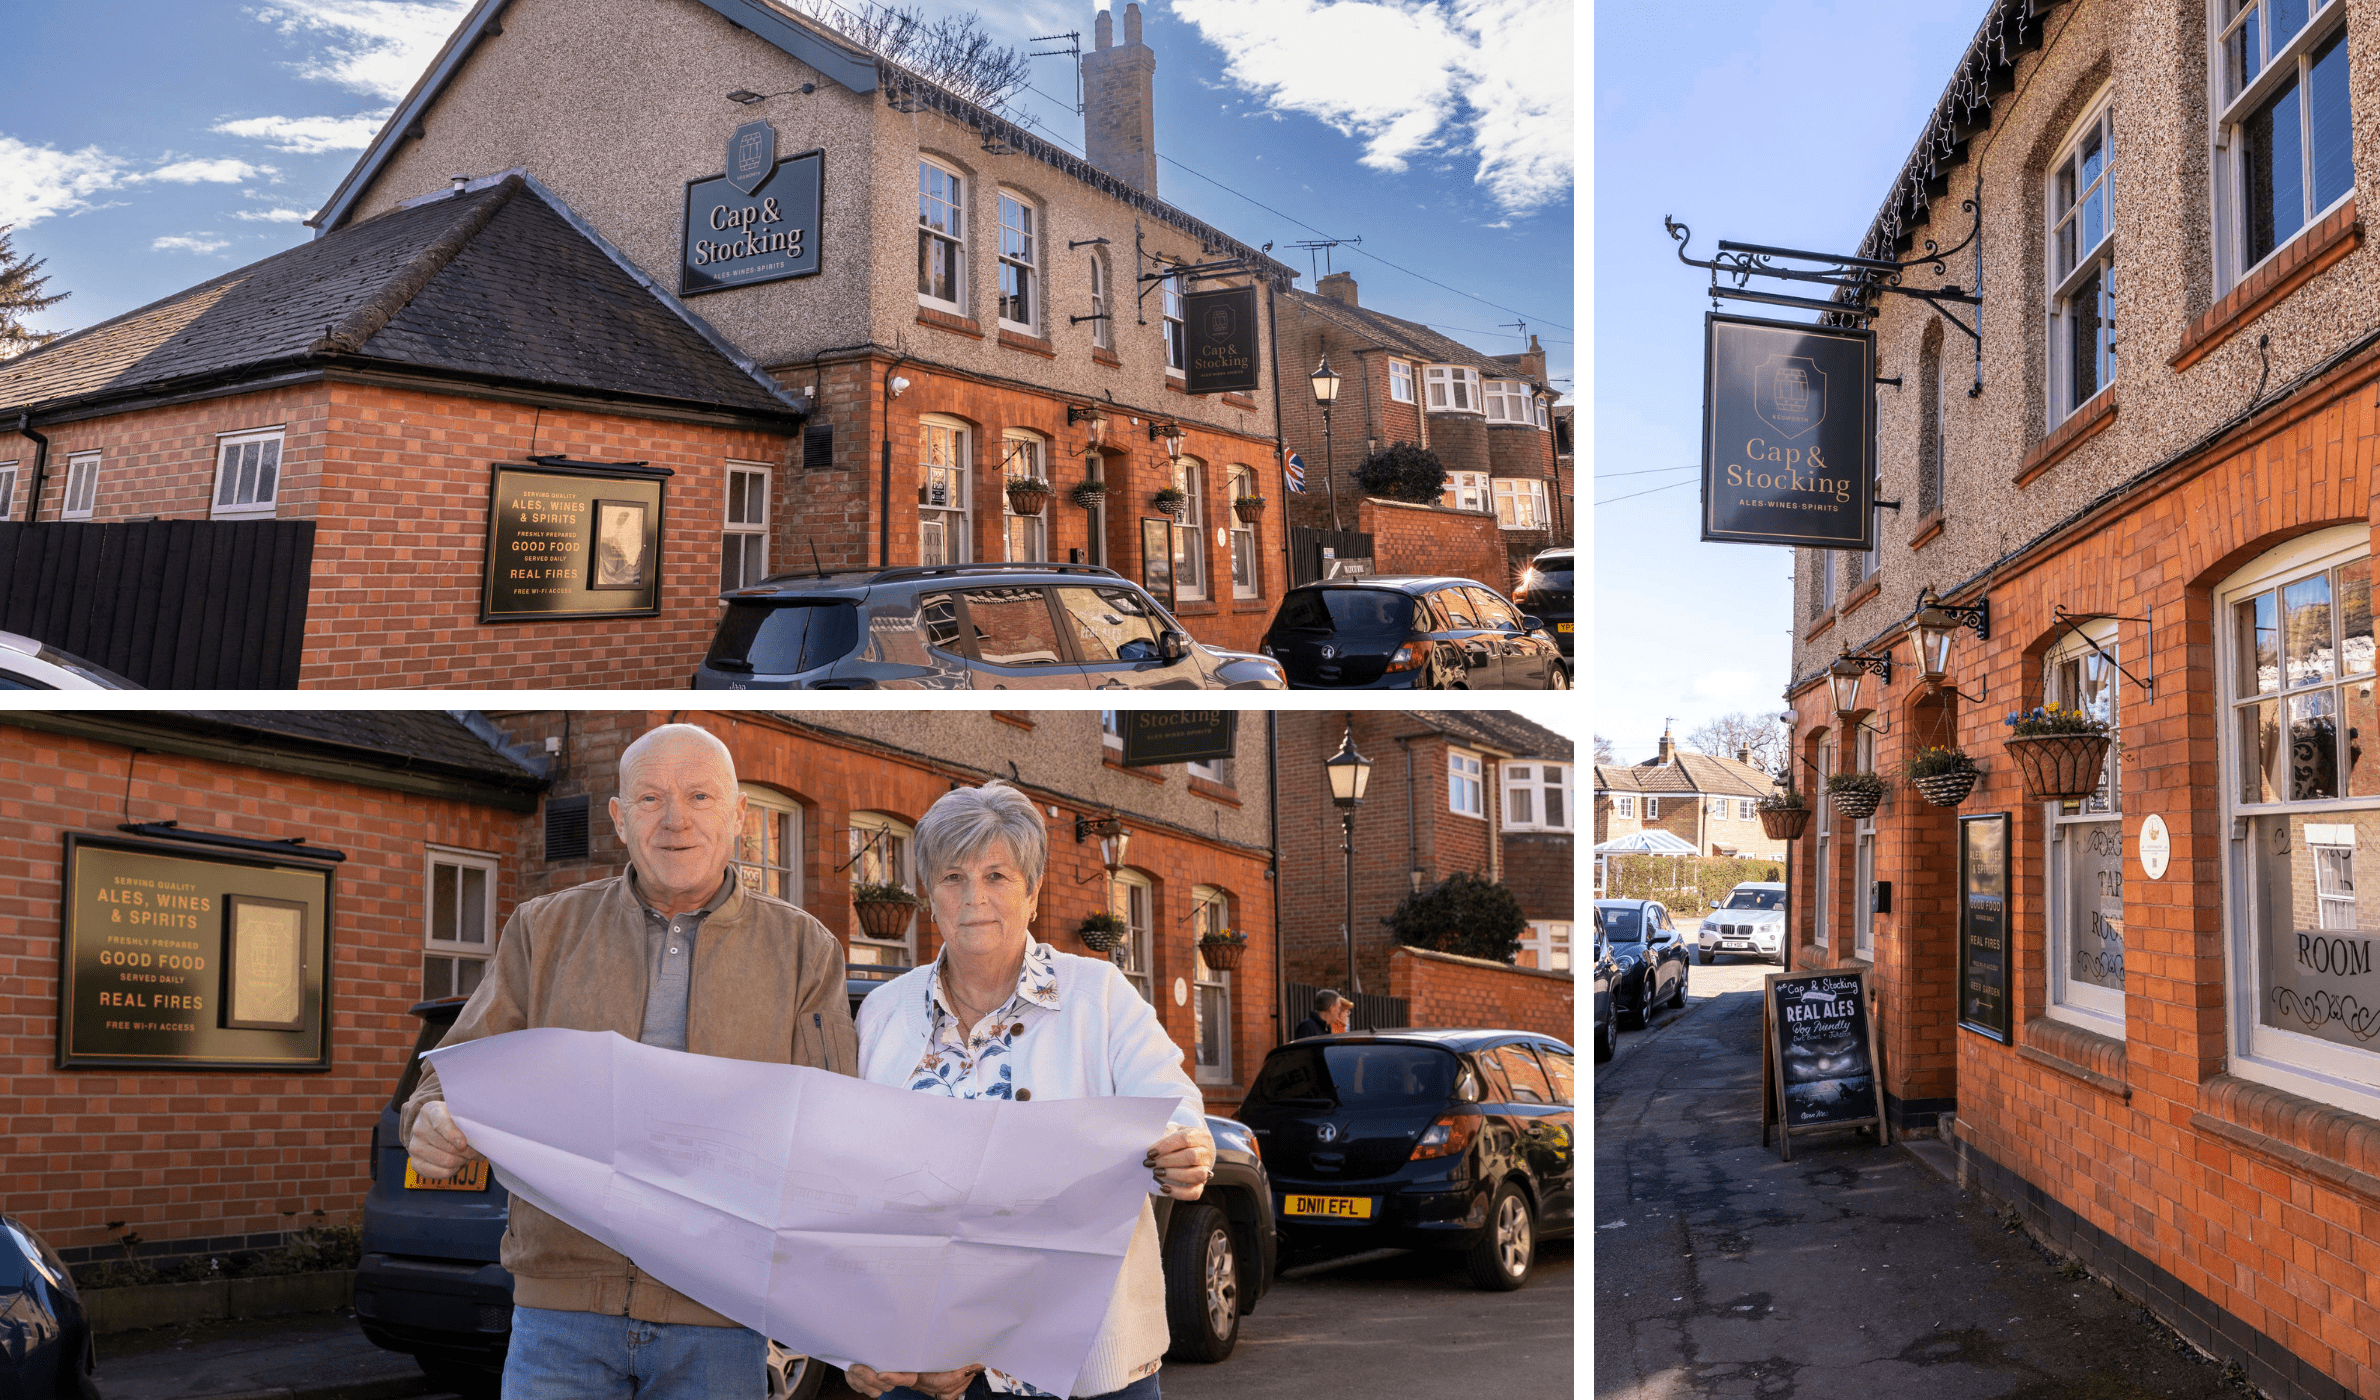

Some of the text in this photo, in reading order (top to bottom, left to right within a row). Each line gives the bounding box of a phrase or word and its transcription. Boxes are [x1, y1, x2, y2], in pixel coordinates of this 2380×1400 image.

[710, 197, 781, 234] Cap &
[695, 228, 802, 265] Stocking
[1202, 344, 1238, 358] Cap &
[1195, 356, 1249, 369] Stocking
[1746, 438, 1828, 470] Cap &
[1727, 464, 1851, 503] Stocking
[512, 500, 585, 512] ALES, WINES
[520, 513, 576, 524] & SPIRITS
[512, 541, 580, 552] GOOD FOOD
[510, 569, 578, 579] REAL FIRES
[1140, 710, 1220, 728] Stocking
[114, 876, 196, 892] SERVING QUALITY
[2098, 870, 2122, 897] TAP
[98, 888, 211, 912] ALES, WINES
[1986, 902, 2000, 912] FOOD
[111, 908, 198, 929] & SPIRITS
[2092, 910, 2123, 942] ROO
[108, 936, 199, 950] FRESHLY PREPARED
[1970, 934, 2000, 950] REAL FIRES
[100, 950, 205, 970] GOOD FOOD
[2297, 932, 2372, 976] ROOM
[120, 973, 184, 984] SERVED DAILY
[1788, 984, 1805, 997] Cap
[1810, 980, 1819, 990] &
[1822, 978, 1859, 995] Stocking
[100, 992, 204, 1010] REAL FIRES
[1786, 1000, 1855, 1022] REAL ALES
[106, 1020, 195, 1032] FREE WI-FI ACCESS
[1792, 1020, 1851, 1036] Dog Friendly
[1297, 1197, 1358, 1216] DN11 EFL
